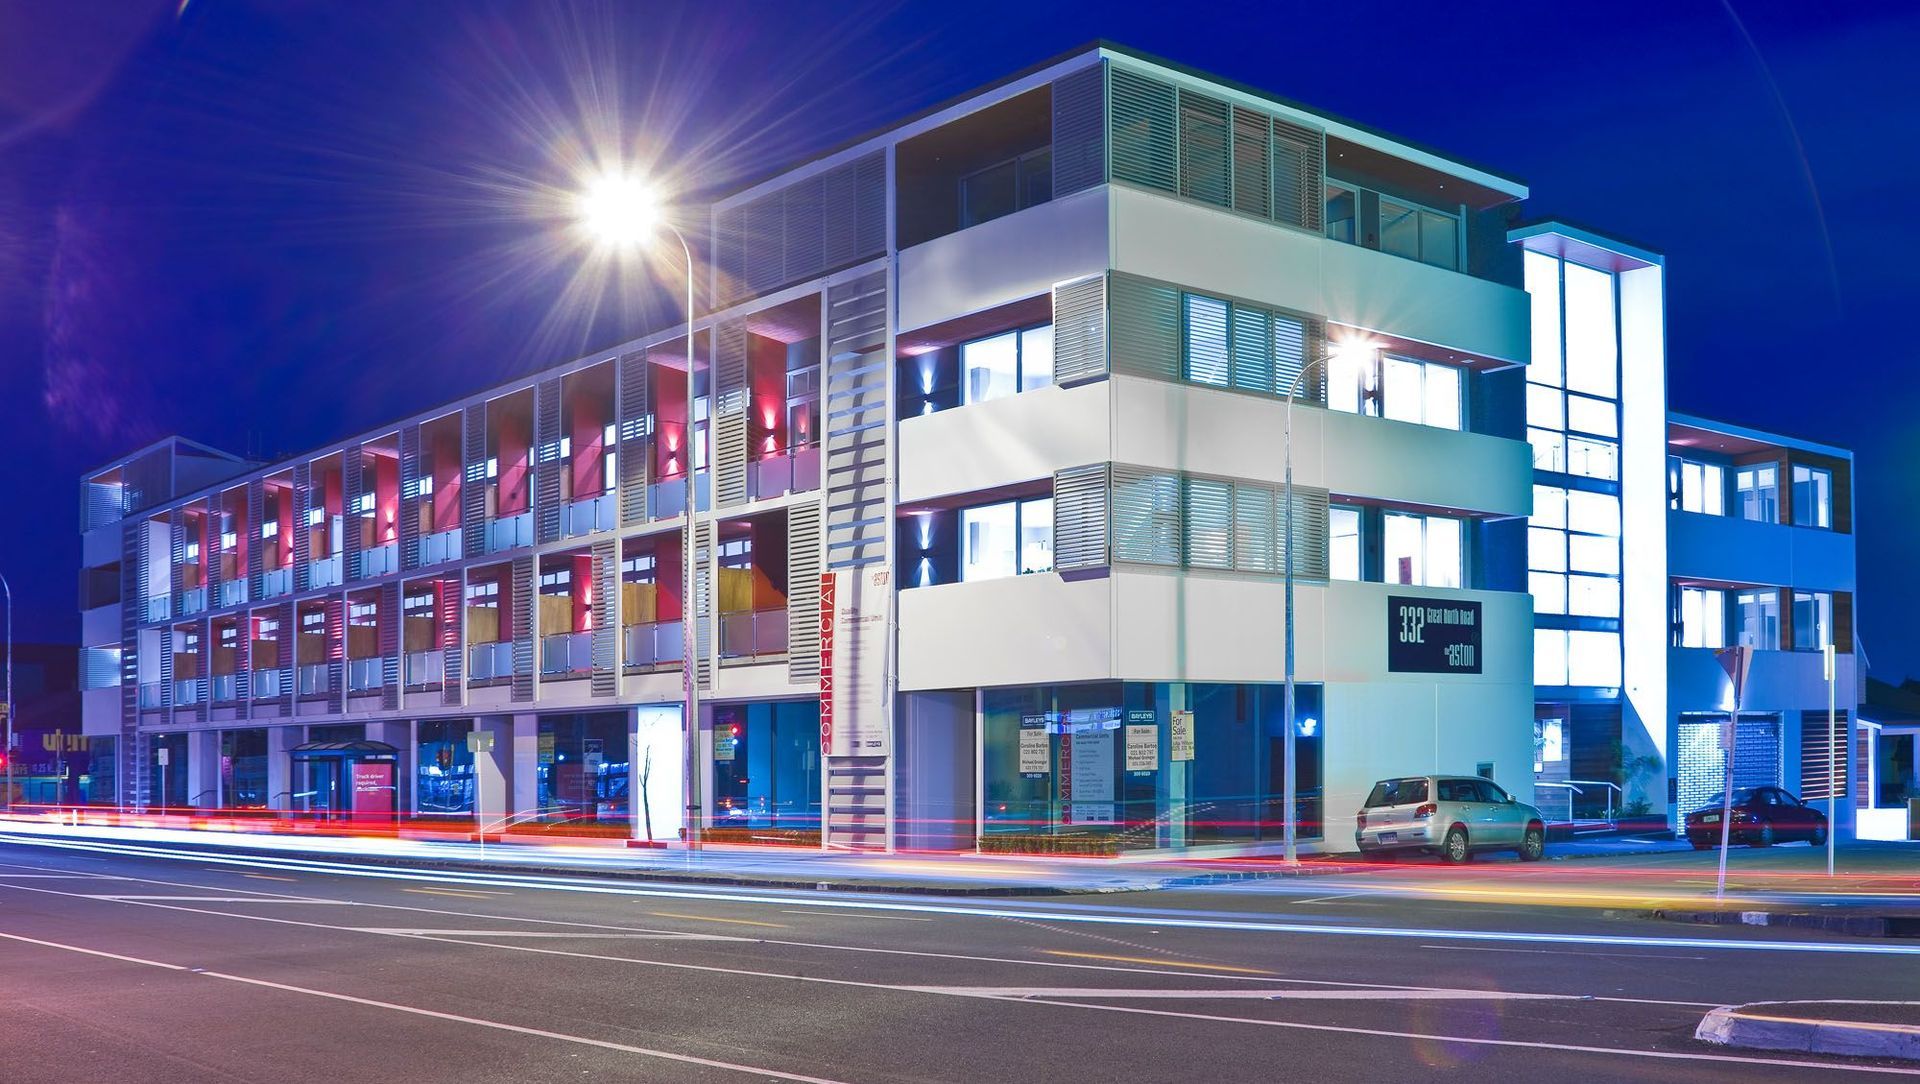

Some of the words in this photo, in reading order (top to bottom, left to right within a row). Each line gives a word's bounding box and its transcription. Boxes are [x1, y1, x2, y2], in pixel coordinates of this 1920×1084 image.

[1400, 606, 1425, 643] 332
[1426, 607, 1443, 624] Great
[1443, 609, 1459, 625] North
[1460, 609, 1475, 626] Road
[819, 572, 836, 756] COMMERCIAL
[1449, 642, 1474, 666] aston
[1173, 717, 1182, 726] For
[1173, 726, 1187, 736] Sale
